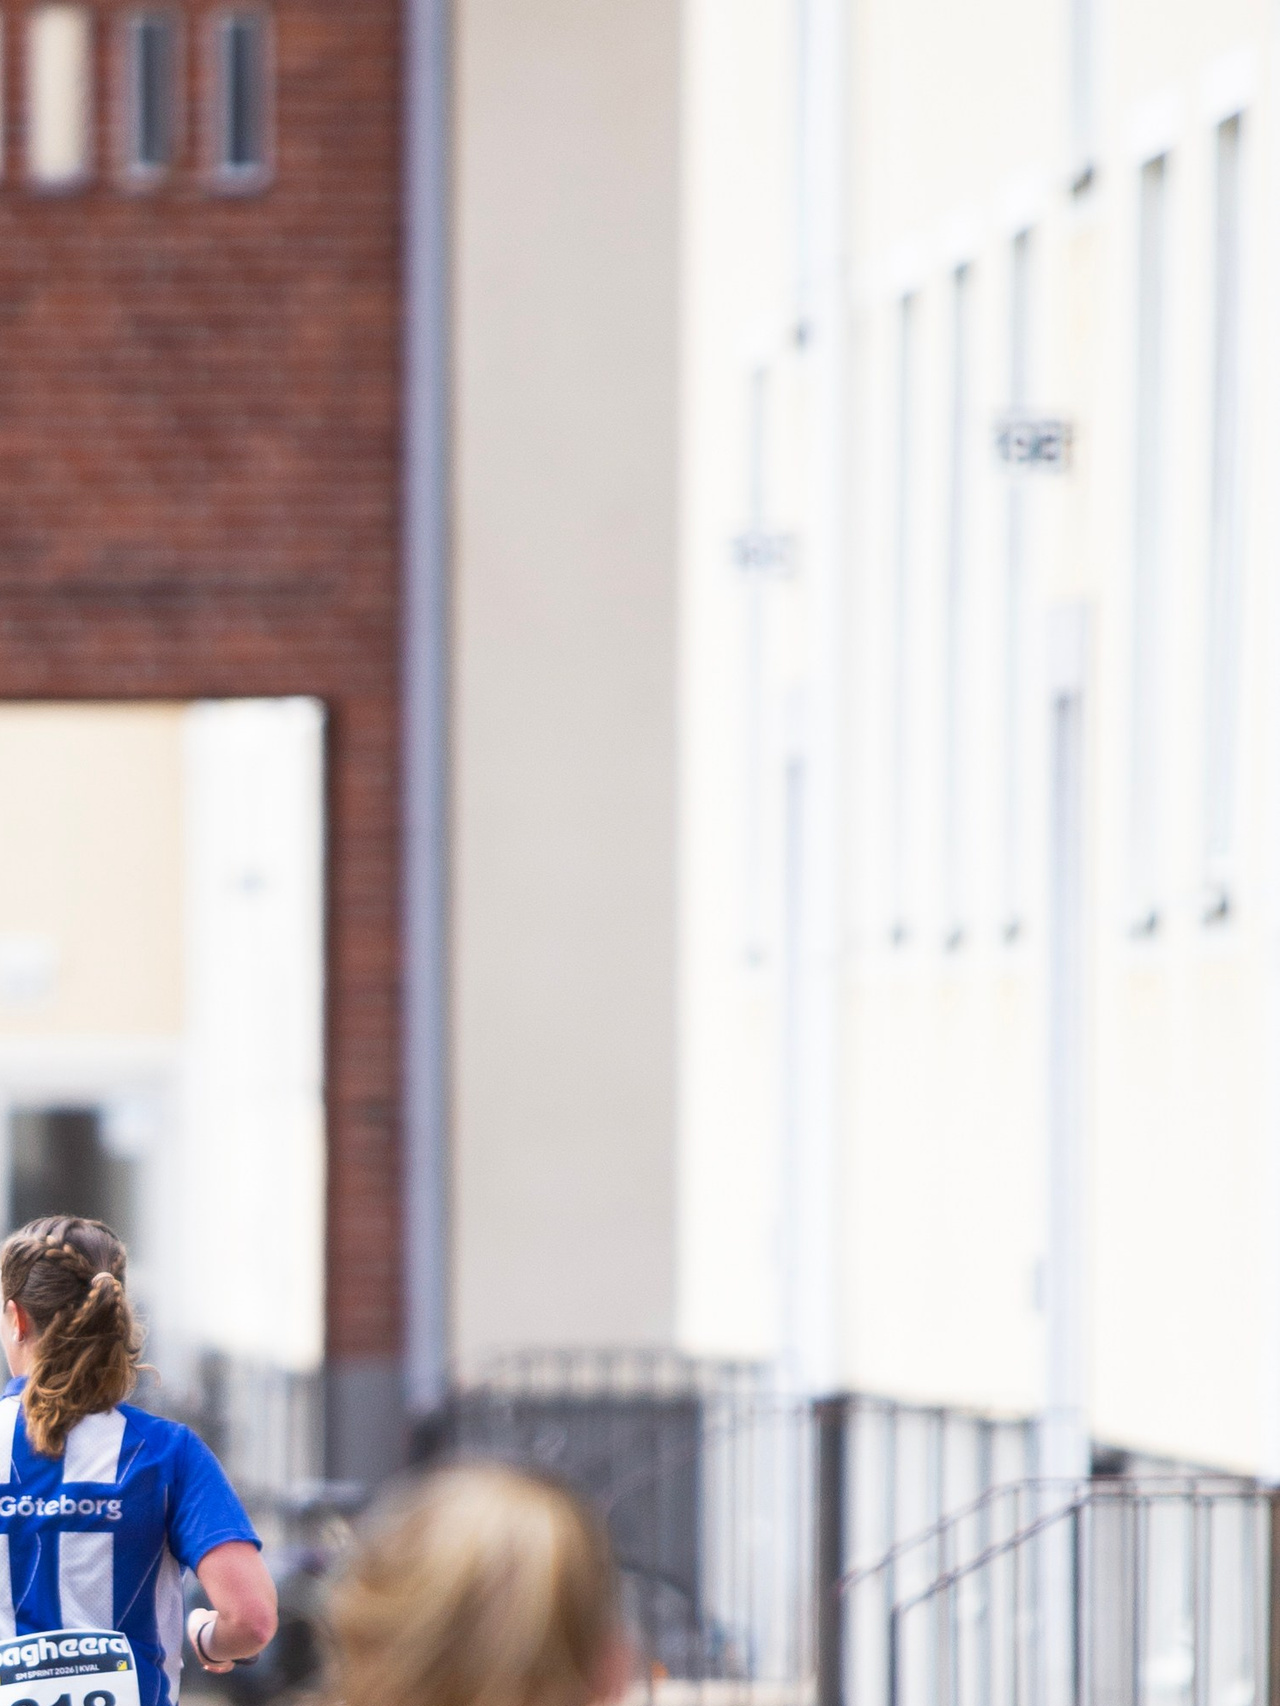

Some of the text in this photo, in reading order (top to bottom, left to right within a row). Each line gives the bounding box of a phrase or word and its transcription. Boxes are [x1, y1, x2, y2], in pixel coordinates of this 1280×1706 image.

[15, 1672, 28, 1681] SM
[28, 1668, 54, 1680] SPRINT
[54, 1667, 74, 1676] 2026
[79, 1664, 100, 1673] KVAL
